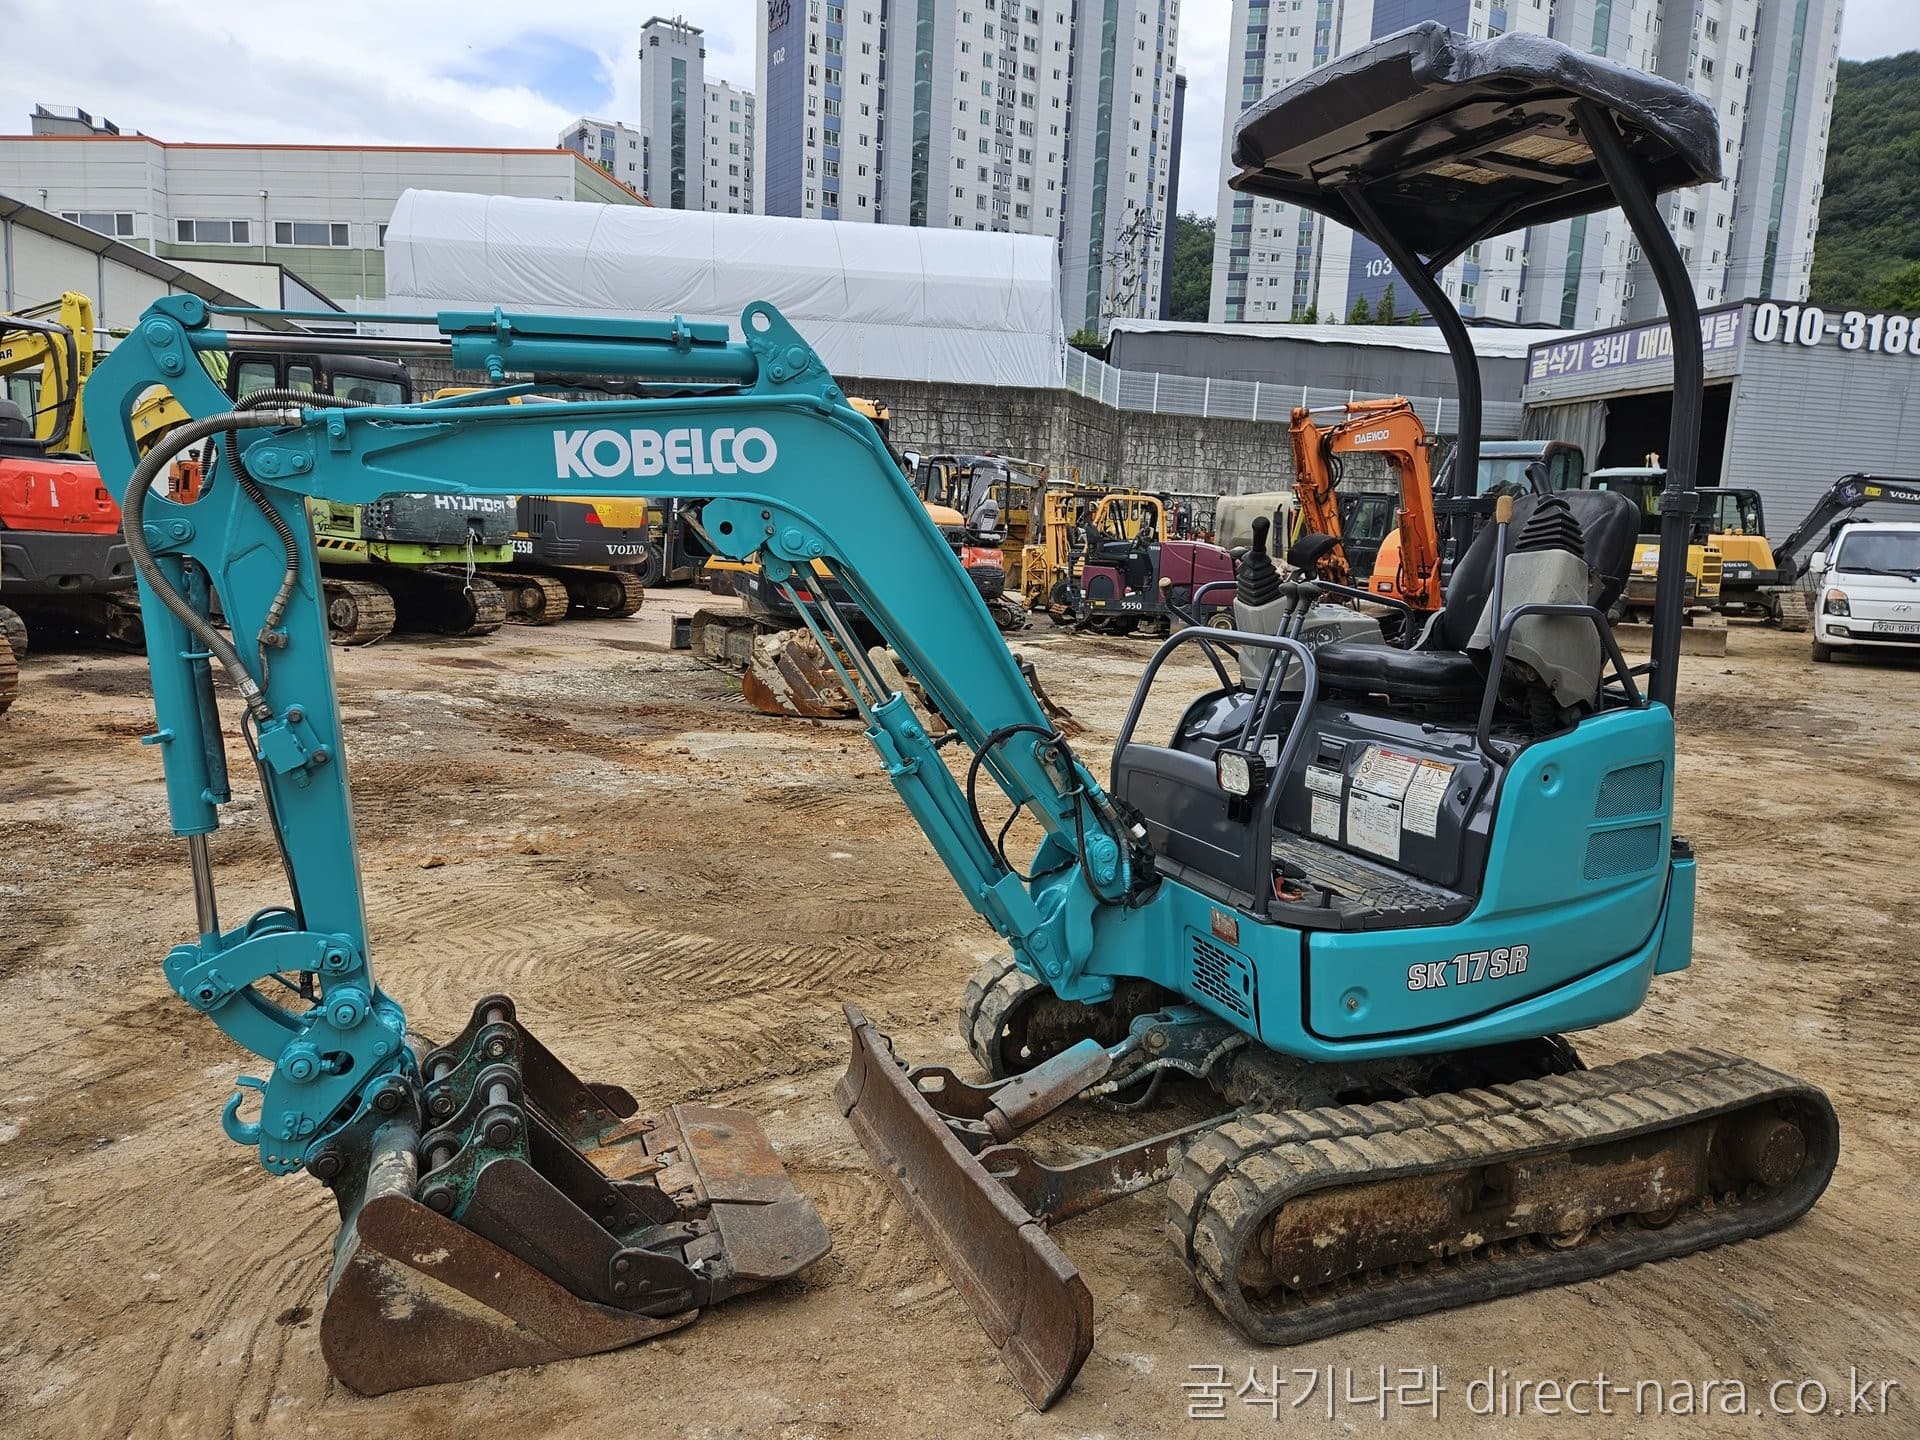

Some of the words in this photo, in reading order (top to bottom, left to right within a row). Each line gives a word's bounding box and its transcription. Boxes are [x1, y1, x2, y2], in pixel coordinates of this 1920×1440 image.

[773, 47, 785, 66] 102
[1365, 257, 1393, 278] 103
[1532, 342, 1585, 378] 굴삭기
[1591, 333, 1630, 368] 정비
[1354, 430, 1389, 444] DAEWOO
[553, 427, 777, 478] KOBELCO
[606, 544, 645, 555] VOLVO
[1121, 601, 1142, 610] 5550
